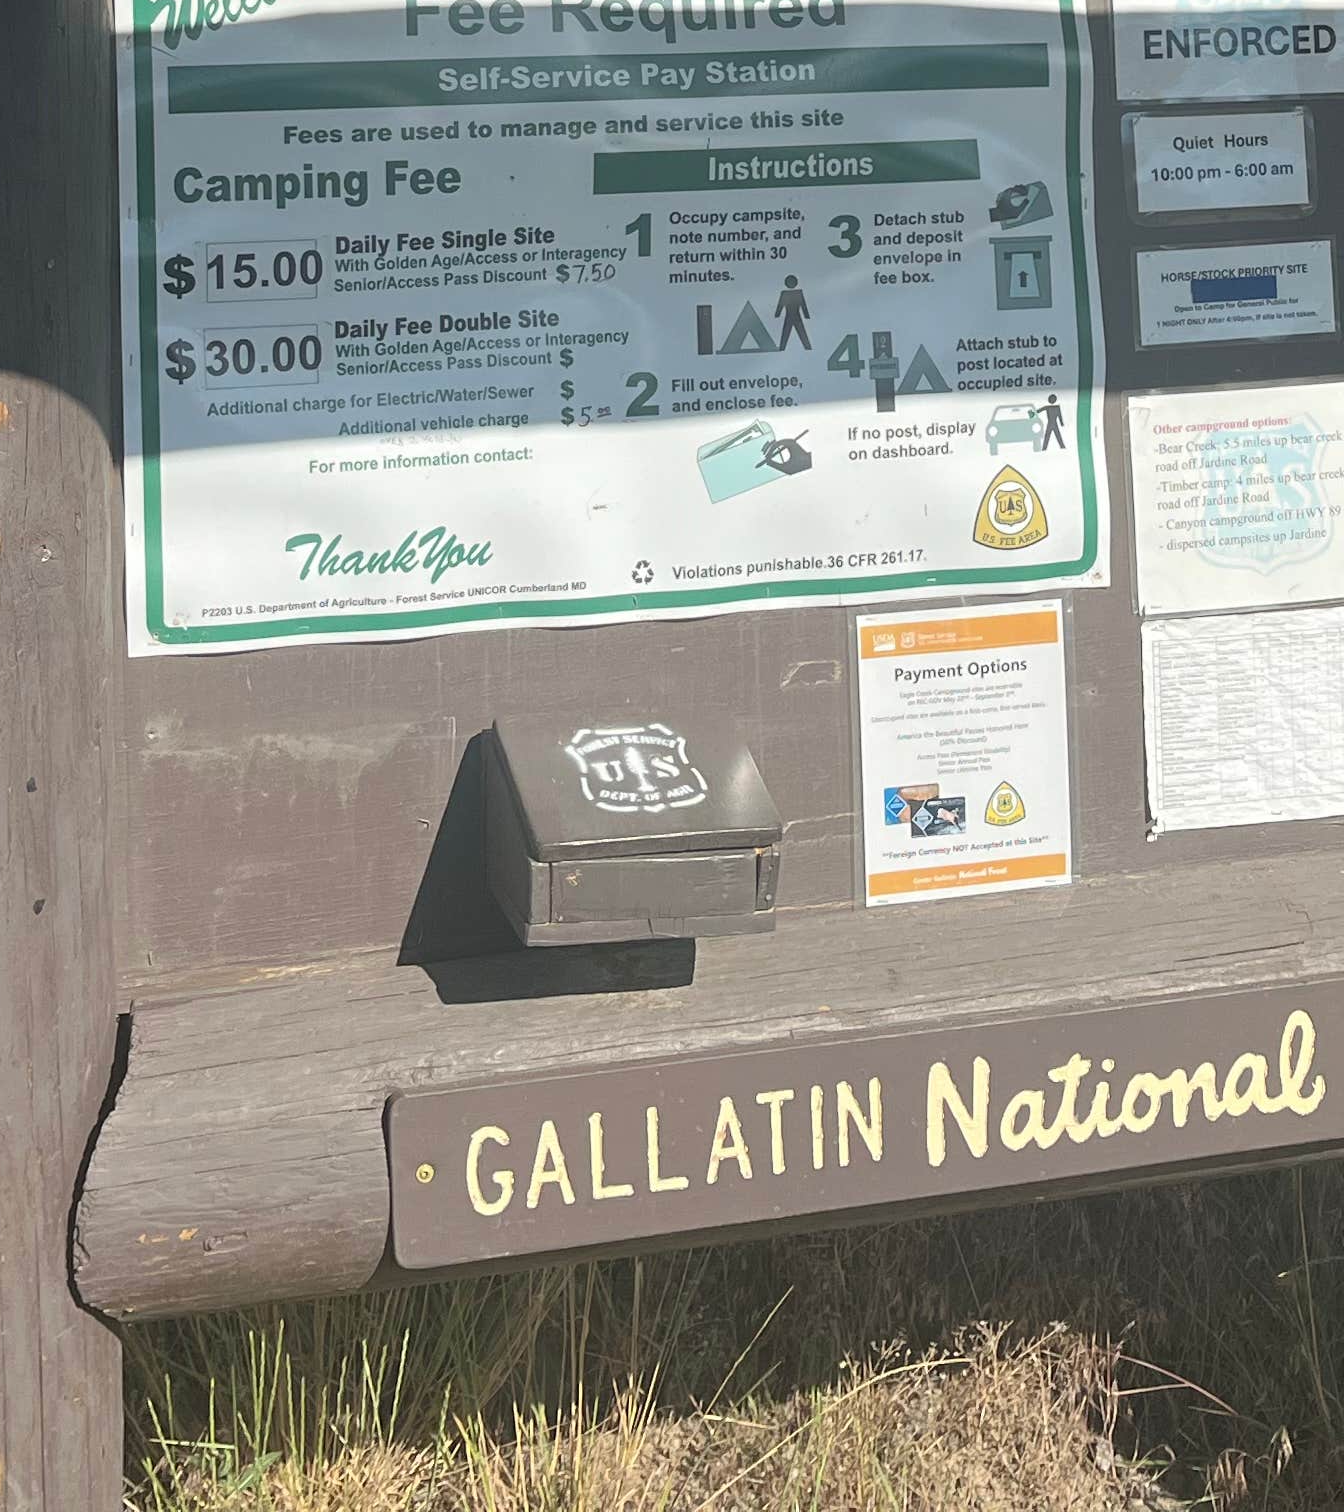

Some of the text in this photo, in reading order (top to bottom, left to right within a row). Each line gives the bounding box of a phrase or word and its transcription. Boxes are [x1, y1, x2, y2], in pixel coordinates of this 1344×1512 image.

[1144, 25, 1335, 60] ENFORCED
[438, 58, 816, 93] Self-Service Pay Station
[284, 108, 844, 144] Fees are used to manage and service this site
[1173, 134, 1268, 152] Quiet Hours
[709, 156, 873, 181] Instructions
[1151, 166, 1193, 182] 10:00
[1197, 168, 1221, 183] pm
[1234, 163, 1267, 178] 6:00
[1270, 164, 1293, 176] am
[173, 158, 461, 212] Camping Fee
[669, 208, 805, 228] Occupy campsite,
[335, 225, 556, 260] Daily Fee Single Site
[626, 213, 651, 257] 1
[669, 226, 802, 244] note number, and
[335, 246, 627, 272] With Golden Age/Access or Interagency
[669, 247, 787, 263] return within 30
[163, 249, 323, 298] $ 15.00
[334, 273, 439, 293] Senior/Access
[443, 271, 478, 286] Pass
[483, 268, 547, 284] Discount
[669, 268, 734, 283] minutes.
[1161, 263, 1308, 285] HORSE/STOCK PRIORITY SITE
[334, 309, 560, 343] Daily Fee Double Site
[165, 336, 322, 384] $ 30.00
[207, 380, 574, 416] Additional charge for Electric/Water/Sewer $
[338, 410, 529, 435] Additional vehicle charge
[1153, 414, 1291, 435] Other campground options:
[309, 445, 533, 474] For more information contact:
[895, 659, 1027, 684] Payment Options
[465, 1078, 885, 1217] GALLATIN
[925, 1009, 1325, 1169] National
